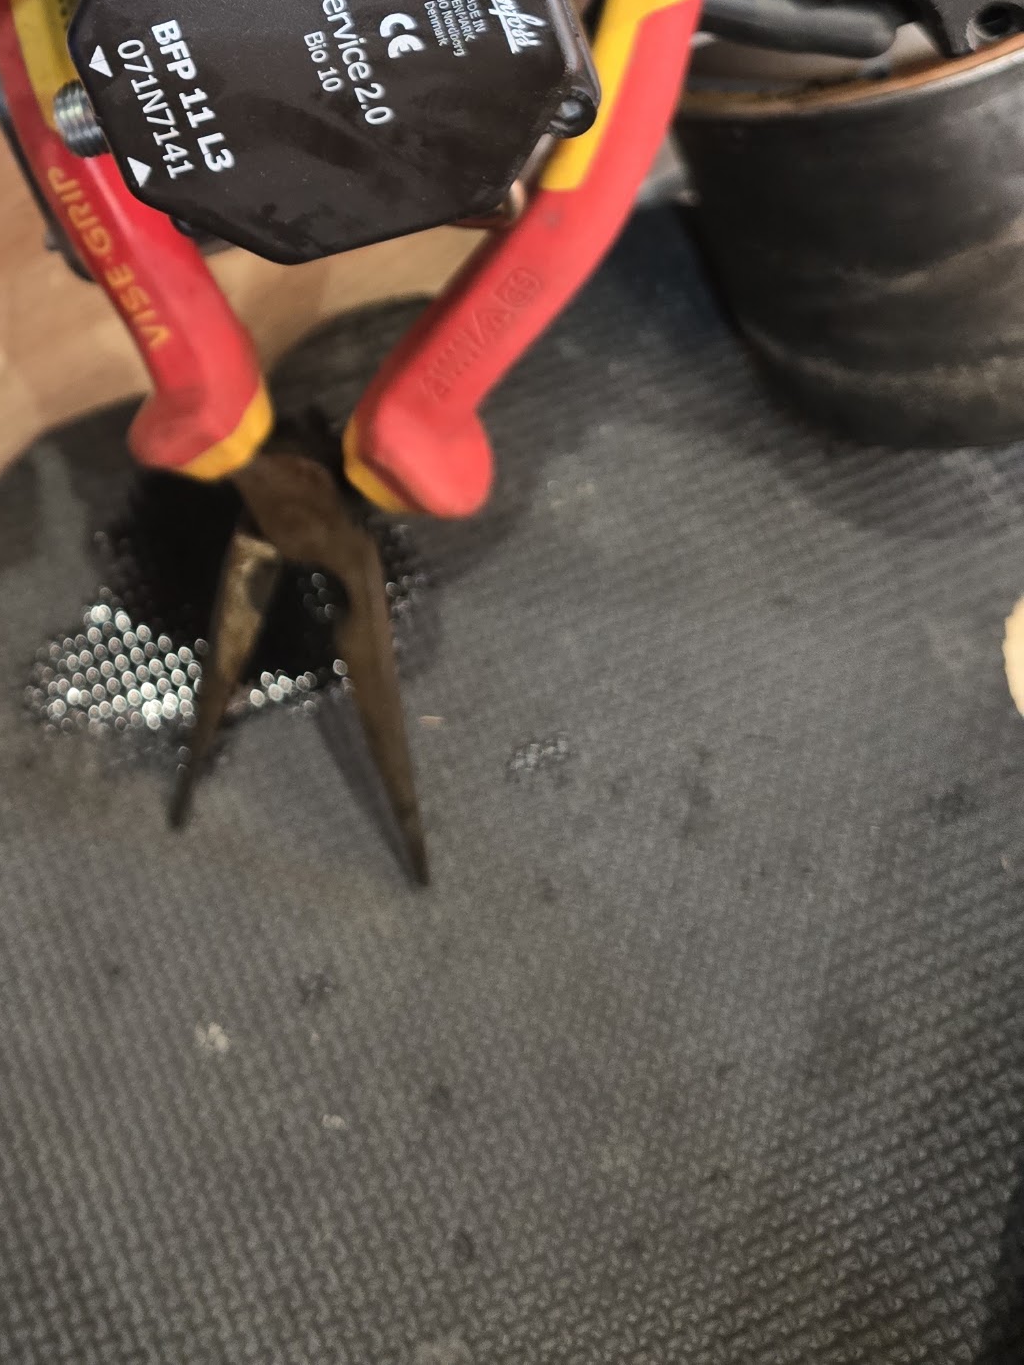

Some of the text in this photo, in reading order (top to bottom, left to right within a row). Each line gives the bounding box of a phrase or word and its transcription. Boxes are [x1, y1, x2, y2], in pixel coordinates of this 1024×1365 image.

[379, 13, 425, 59] CE
[424, 0, 447, 46] Denmark
[441, 8, 465, 56] Nordborg
[472, 19, 487, 33] IN
[304, 31, 343, 92] Bio 10
[118, 39, 194, 179] 071N7141
[151, 19, 235, 172] BFP 11 L3
[354, 82, 394, 125] 2.0
